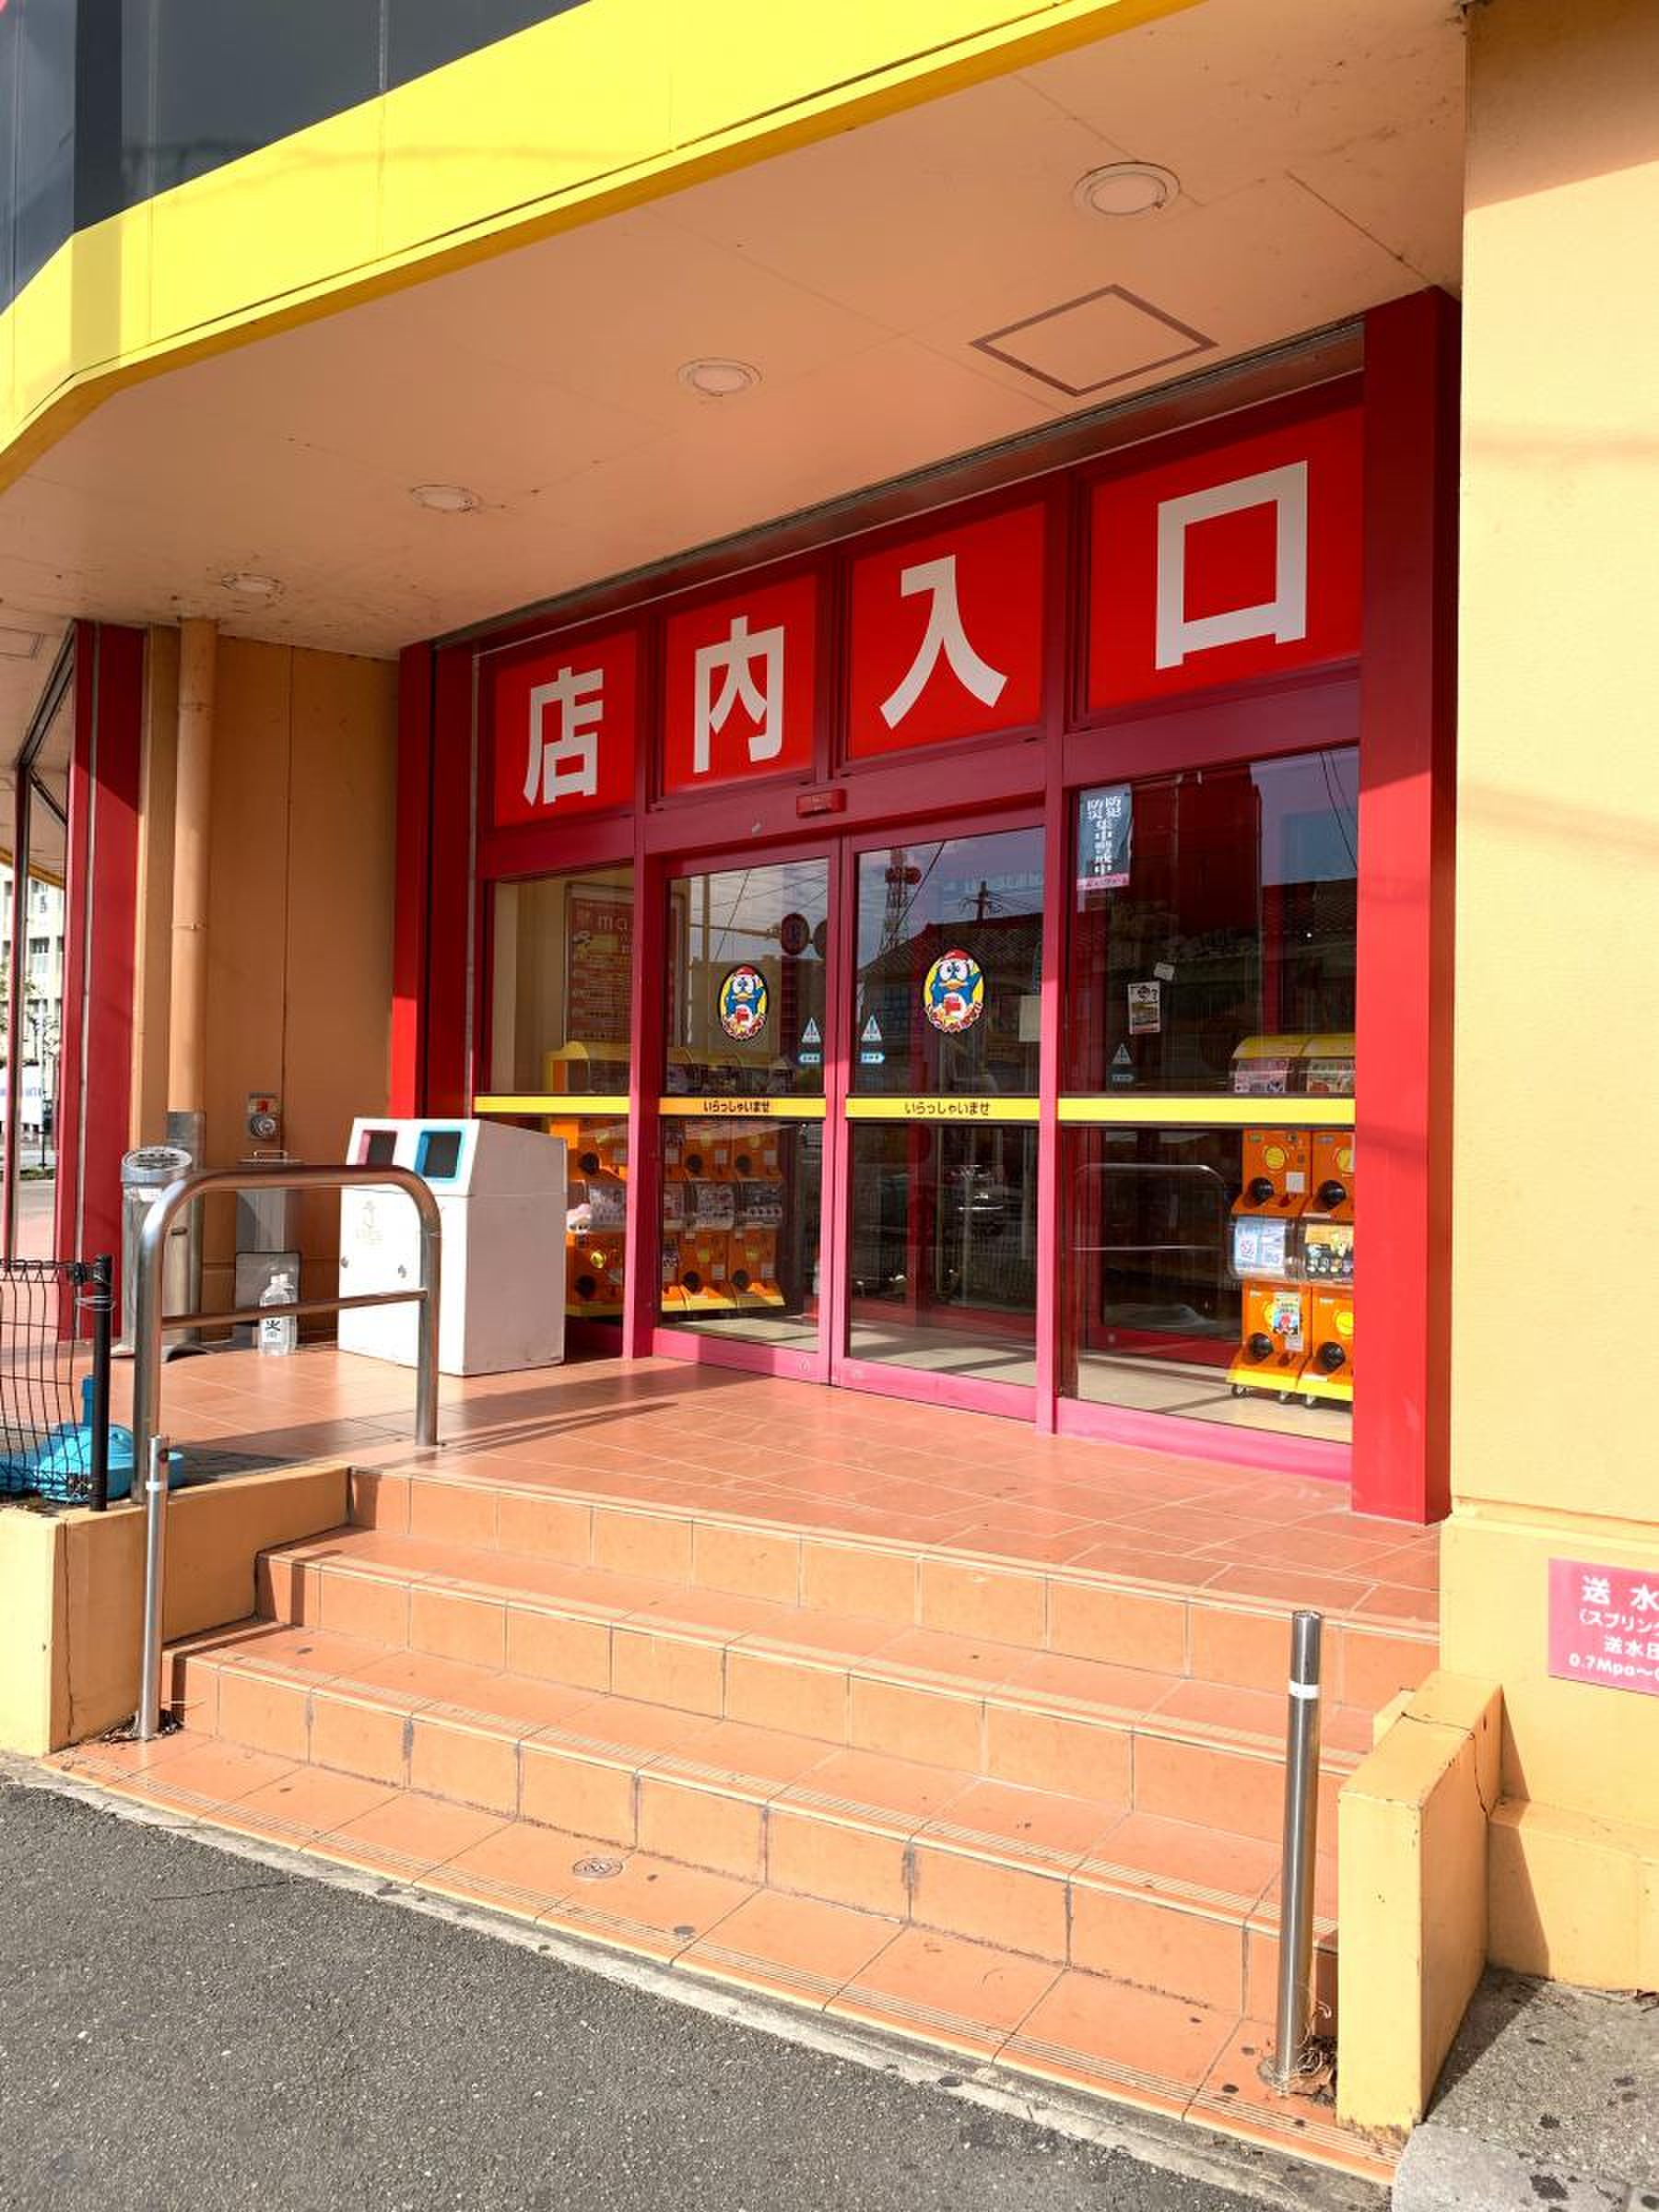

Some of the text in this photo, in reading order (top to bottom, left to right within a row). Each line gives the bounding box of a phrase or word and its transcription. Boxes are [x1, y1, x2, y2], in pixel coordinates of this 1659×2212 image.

[522, 460, 1310, 807] 店内入口
[703, 1100, 770, 1113] いらっしゃいませ
[904, 1100, 990, 1116] いらっしゃいませ
